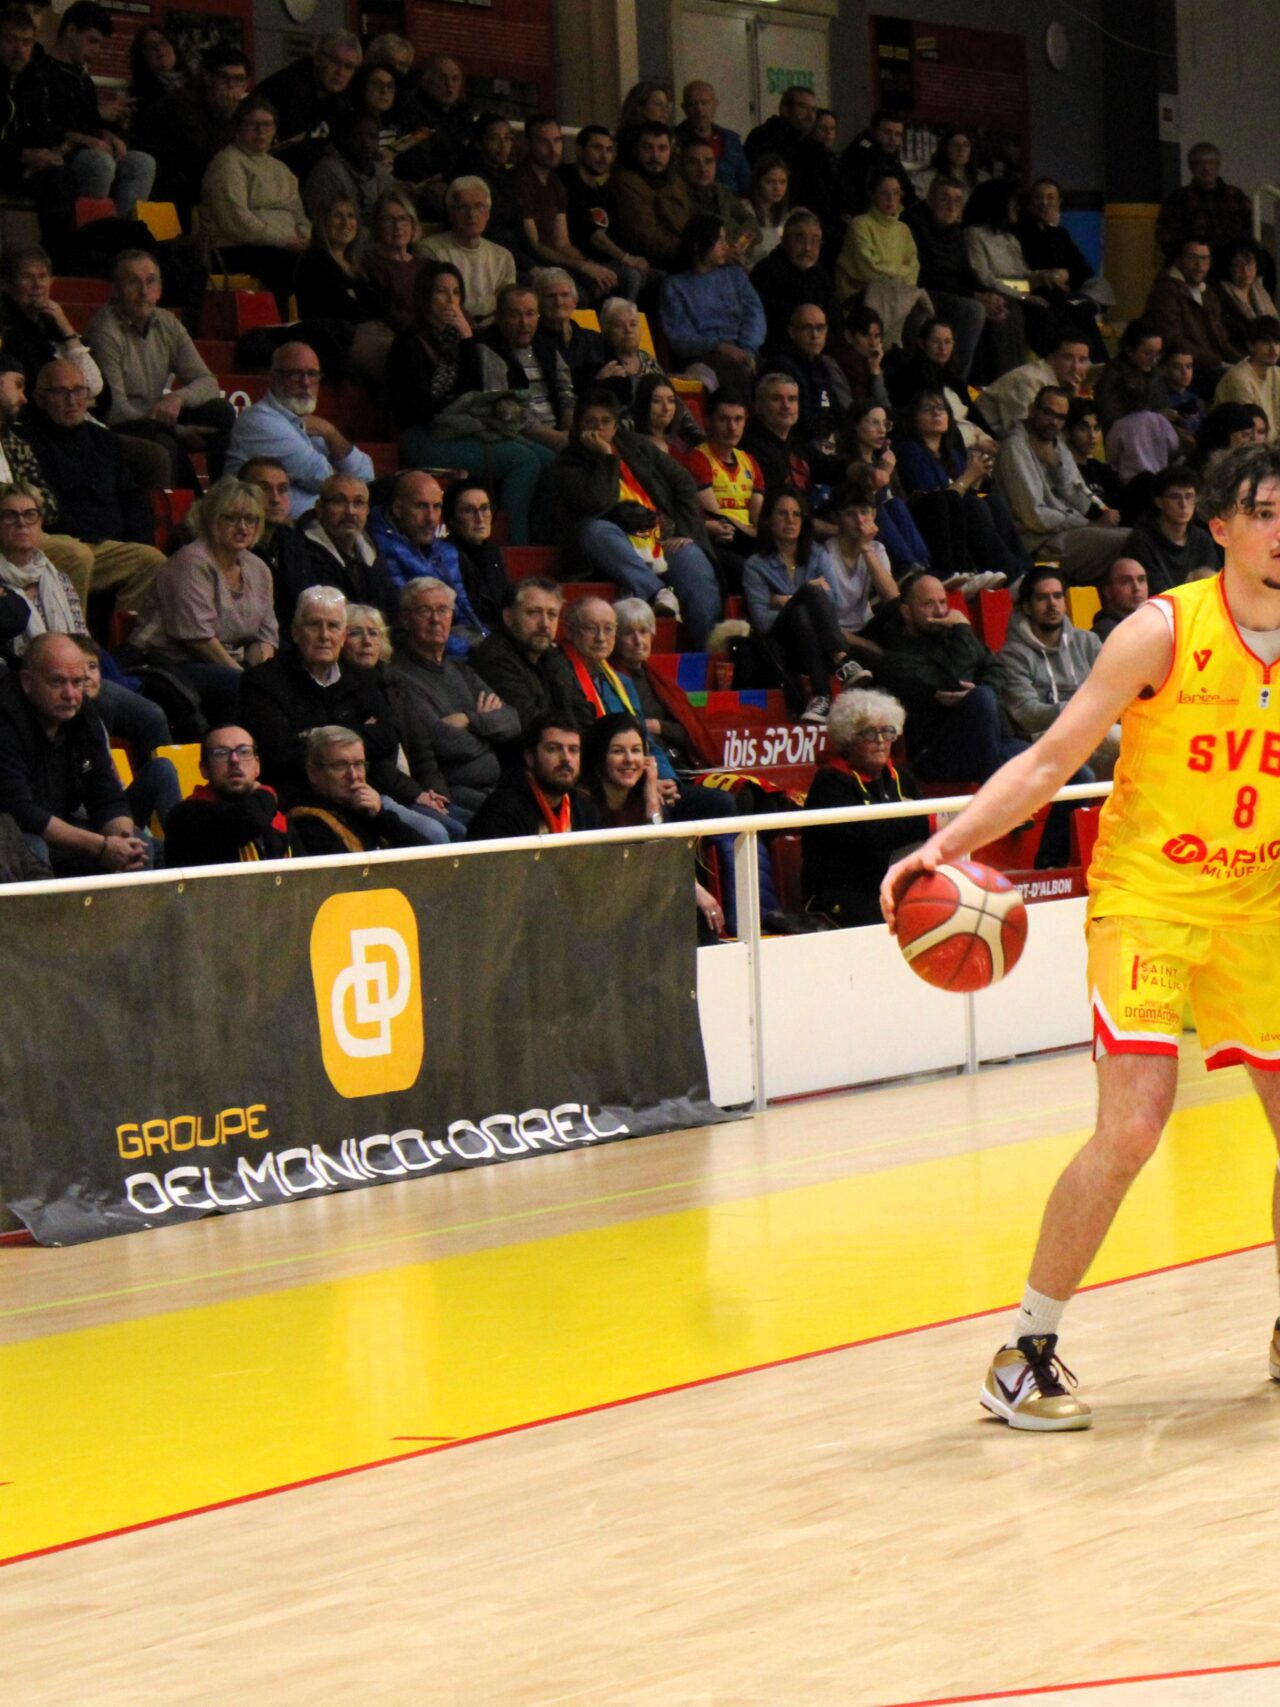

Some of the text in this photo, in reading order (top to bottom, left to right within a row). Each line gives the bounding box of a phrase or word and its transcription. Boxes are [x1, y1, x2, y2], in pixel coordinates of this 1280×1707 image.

[724, 729, 757, 768] ibis
[1233, 785, 1257, 829] 8
[1141, 962, 1178, 978] SAINT
[116, 1103, 269, 1160] GROUPE
